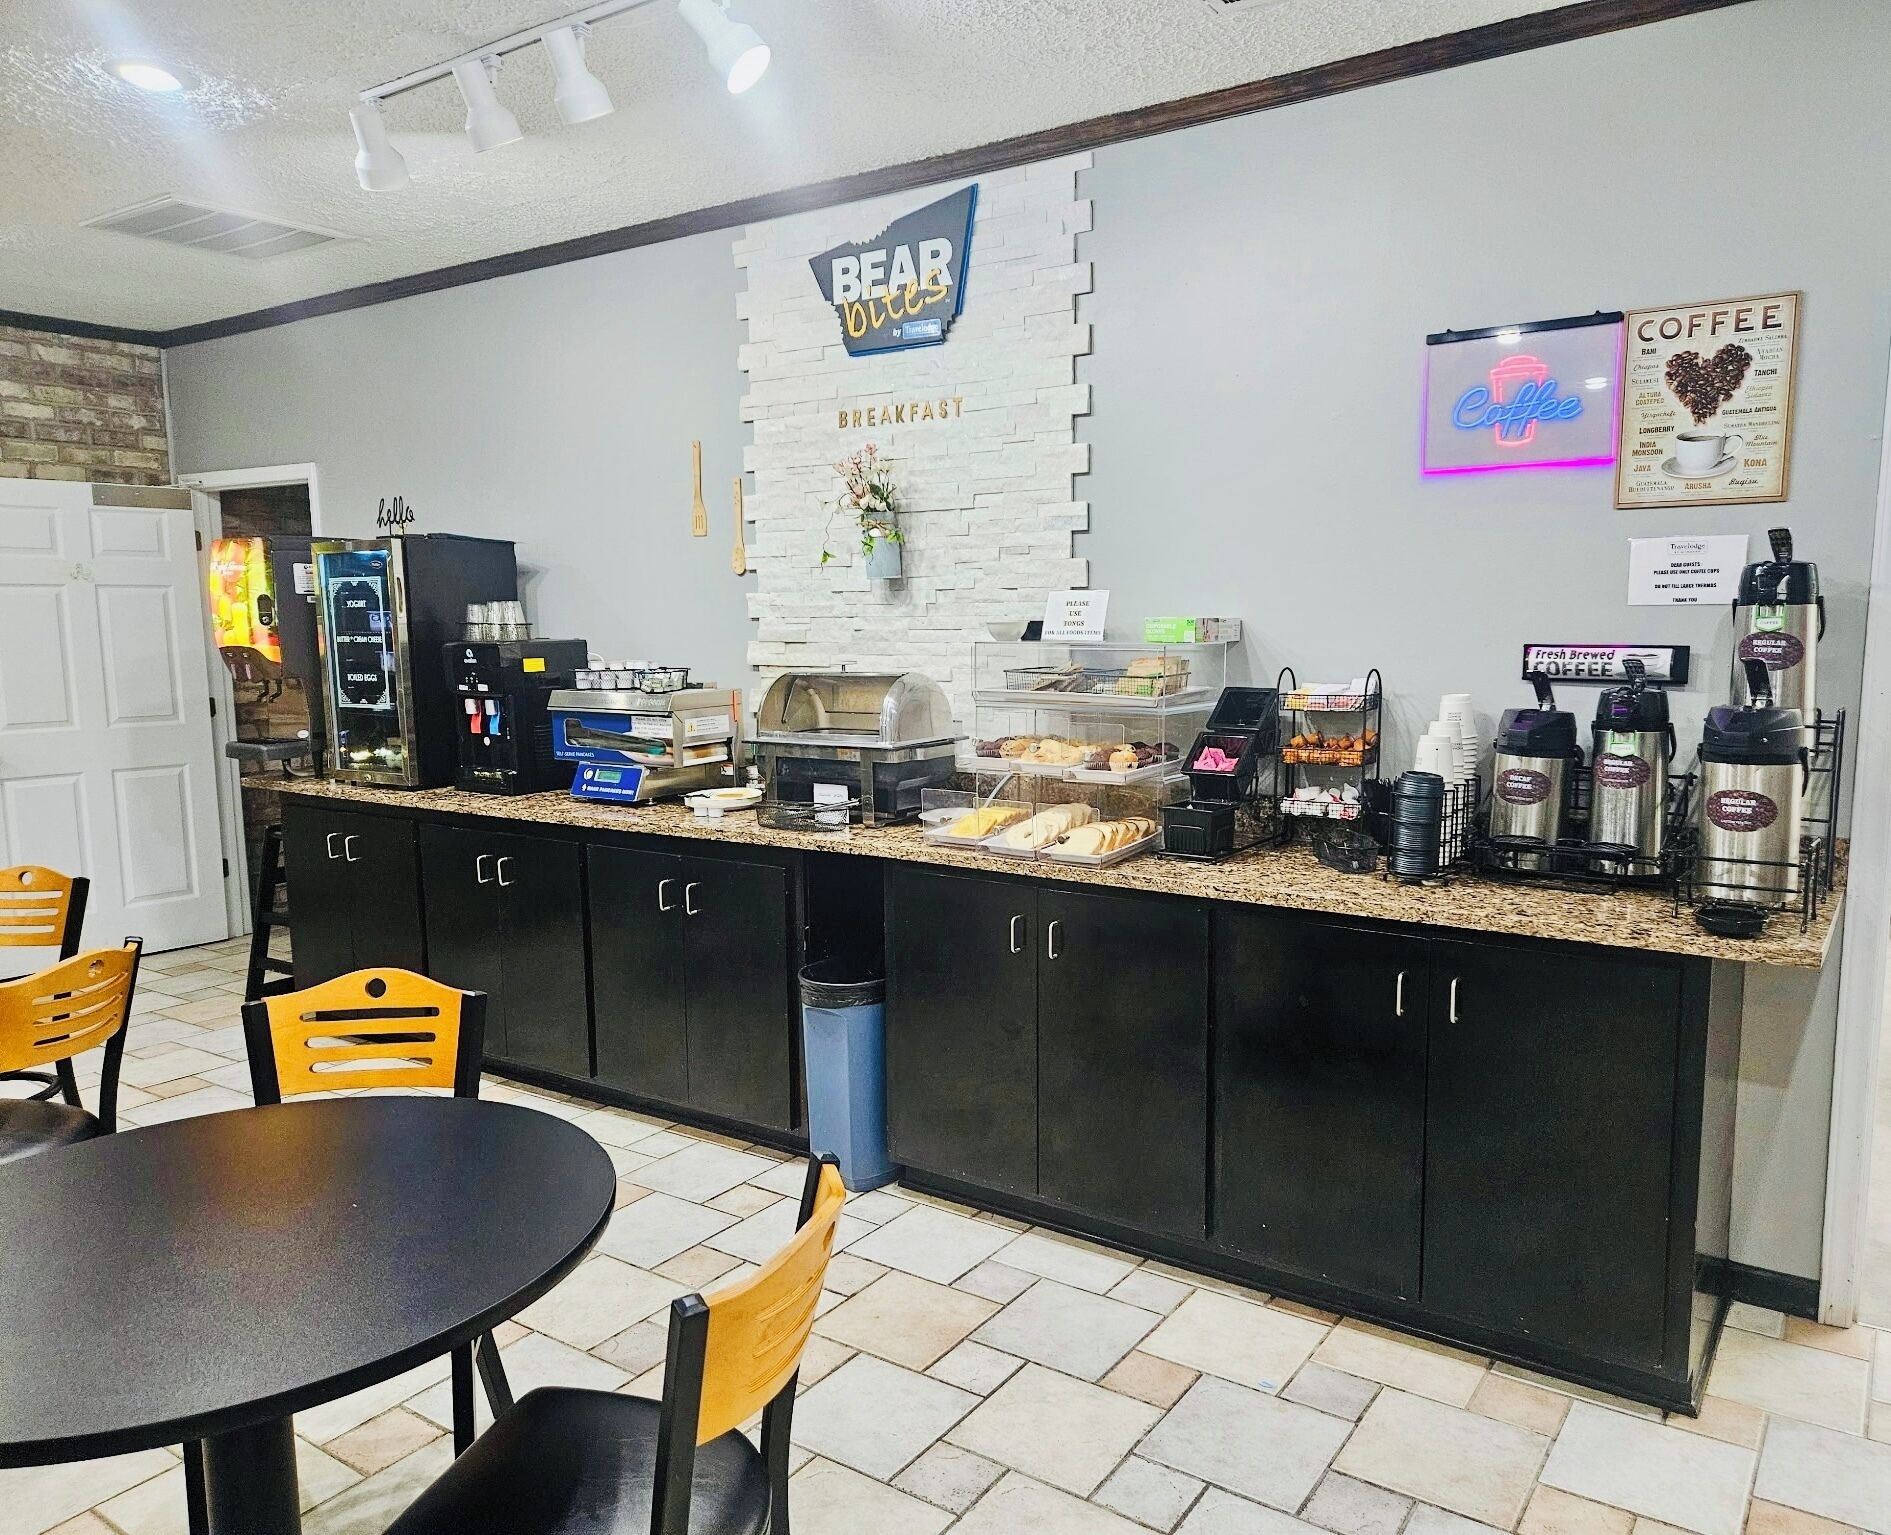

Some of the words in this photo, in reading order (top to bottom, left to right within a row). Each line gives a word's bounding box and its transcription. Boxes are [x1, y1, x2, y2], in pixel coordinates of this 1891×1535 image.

[831, 237, 954, 305] BEAR
[844, 268, 949, 338] bites
[1638, 304, 1782, 342] COFFEE
[892, 328, 901, 337] by
[1754, 368, 1778, 377] TANCHI
[838, 396, 963, 430] BREAKFAST
[1453, 379, 1584, 438] Coffee
[1639, 425, 1675, 434] LONGBERRY
[1639, 441, 1657, 449] INDIA
[1631, 448, 1664, 457] MONSOON
[1743, 458, 1768, 468] KONA
[1633, 464, 1651, 473] JAVA
[1684, 482, 1712, 490] ARUSHA
[376, 495, 416, 529] hello
[1535, 649, 1566, 660] Fresh
[1569, 649, 1616, 661] Brewed
[1533, 660, 1613, 677] COFFEE
[1510, 774, 1532, 782] DECAF
[1720, 797, 1757, 806] REGULAR
[1721, 806, 1753, 814] COFFEE
